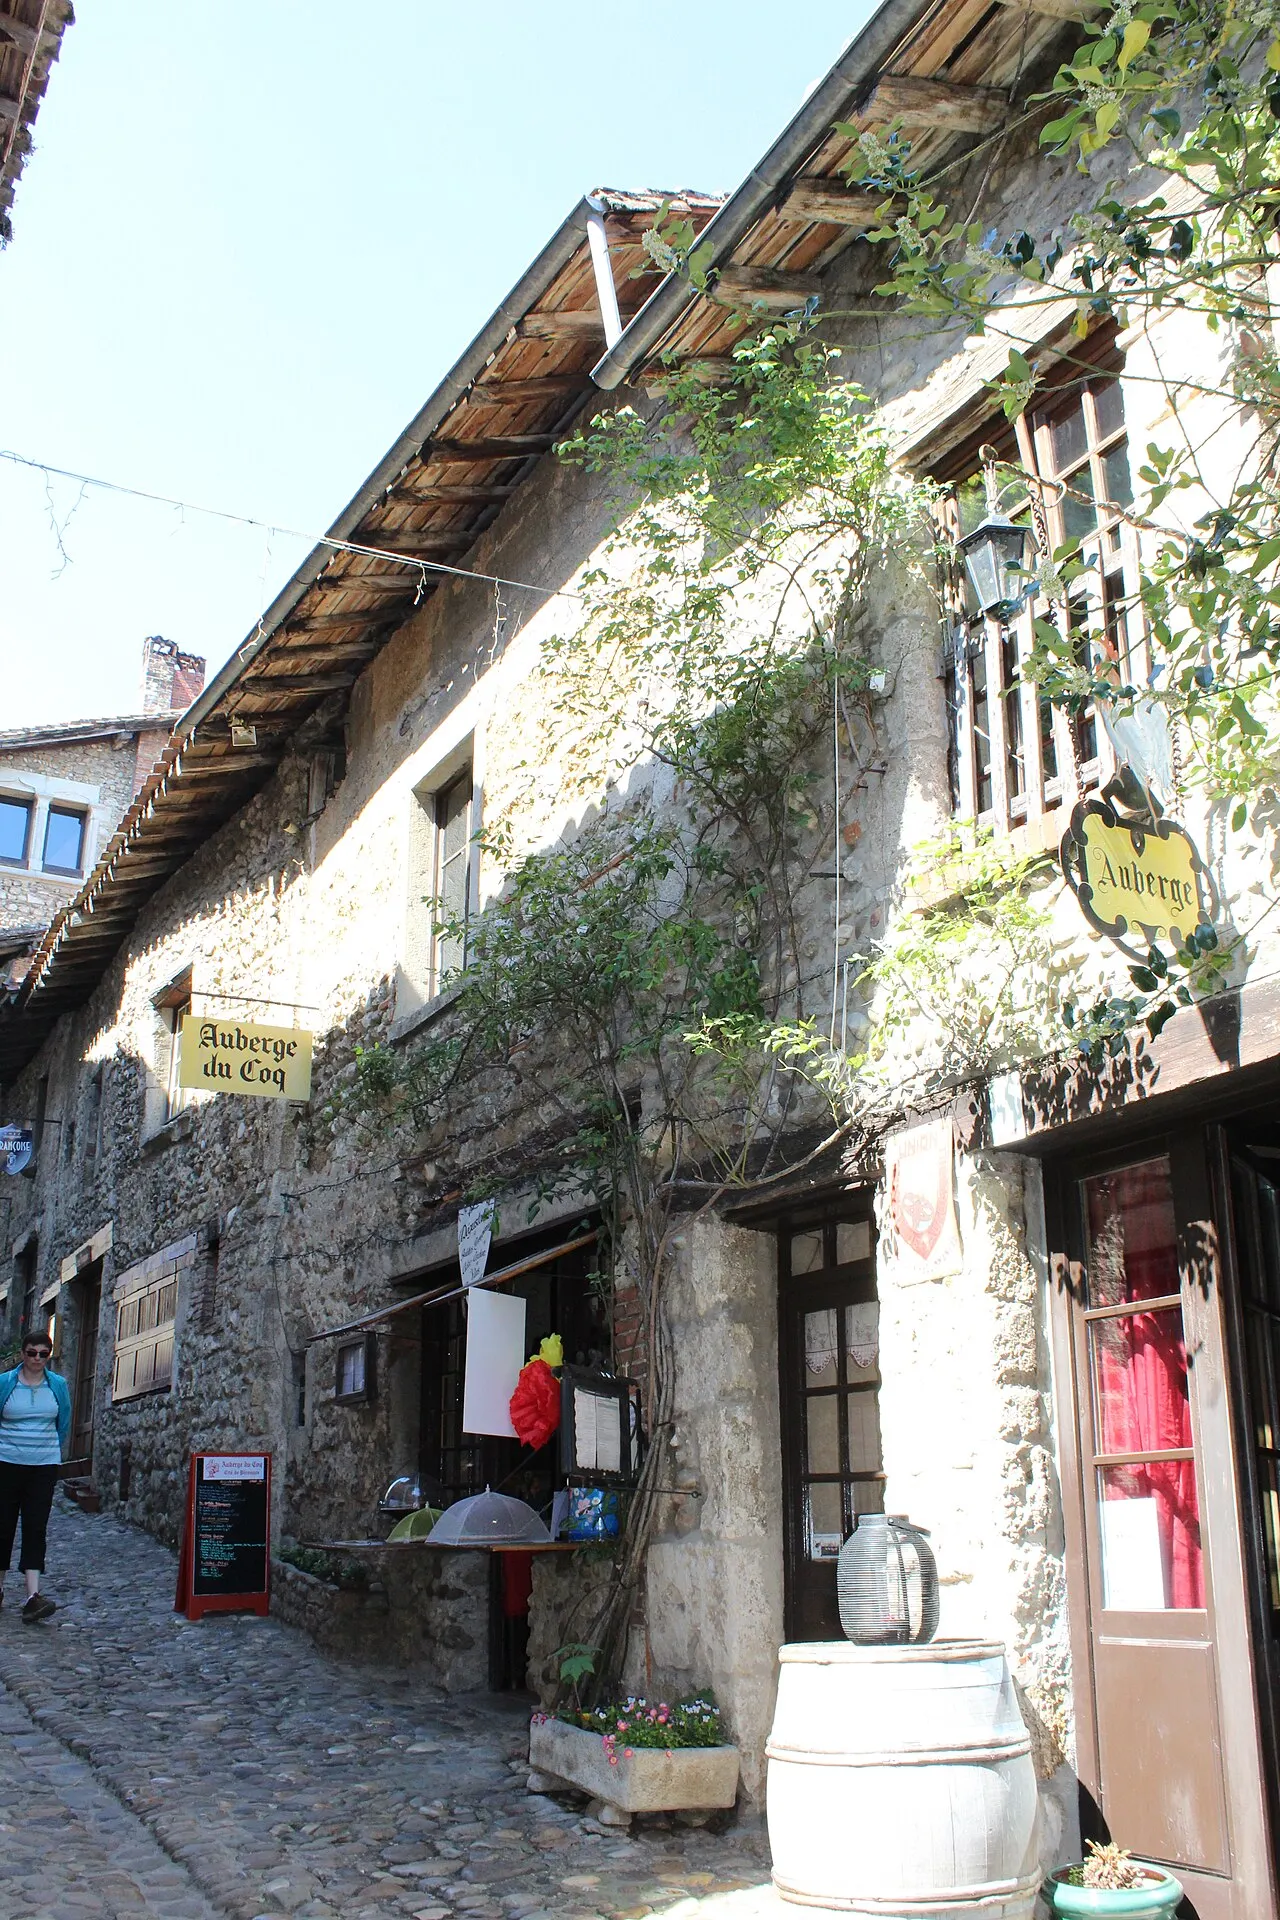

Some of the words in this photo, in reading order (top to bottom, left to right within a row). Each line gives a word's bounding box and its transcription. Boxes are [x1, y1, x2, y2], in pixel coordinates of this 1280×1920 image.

[1093, 847, 1193, 917] Auberge
[199, 1023, 298, 1063] Auberge
[203, 1052, 232, 1080] du
[240, 1058, 286, 1094] Coq
